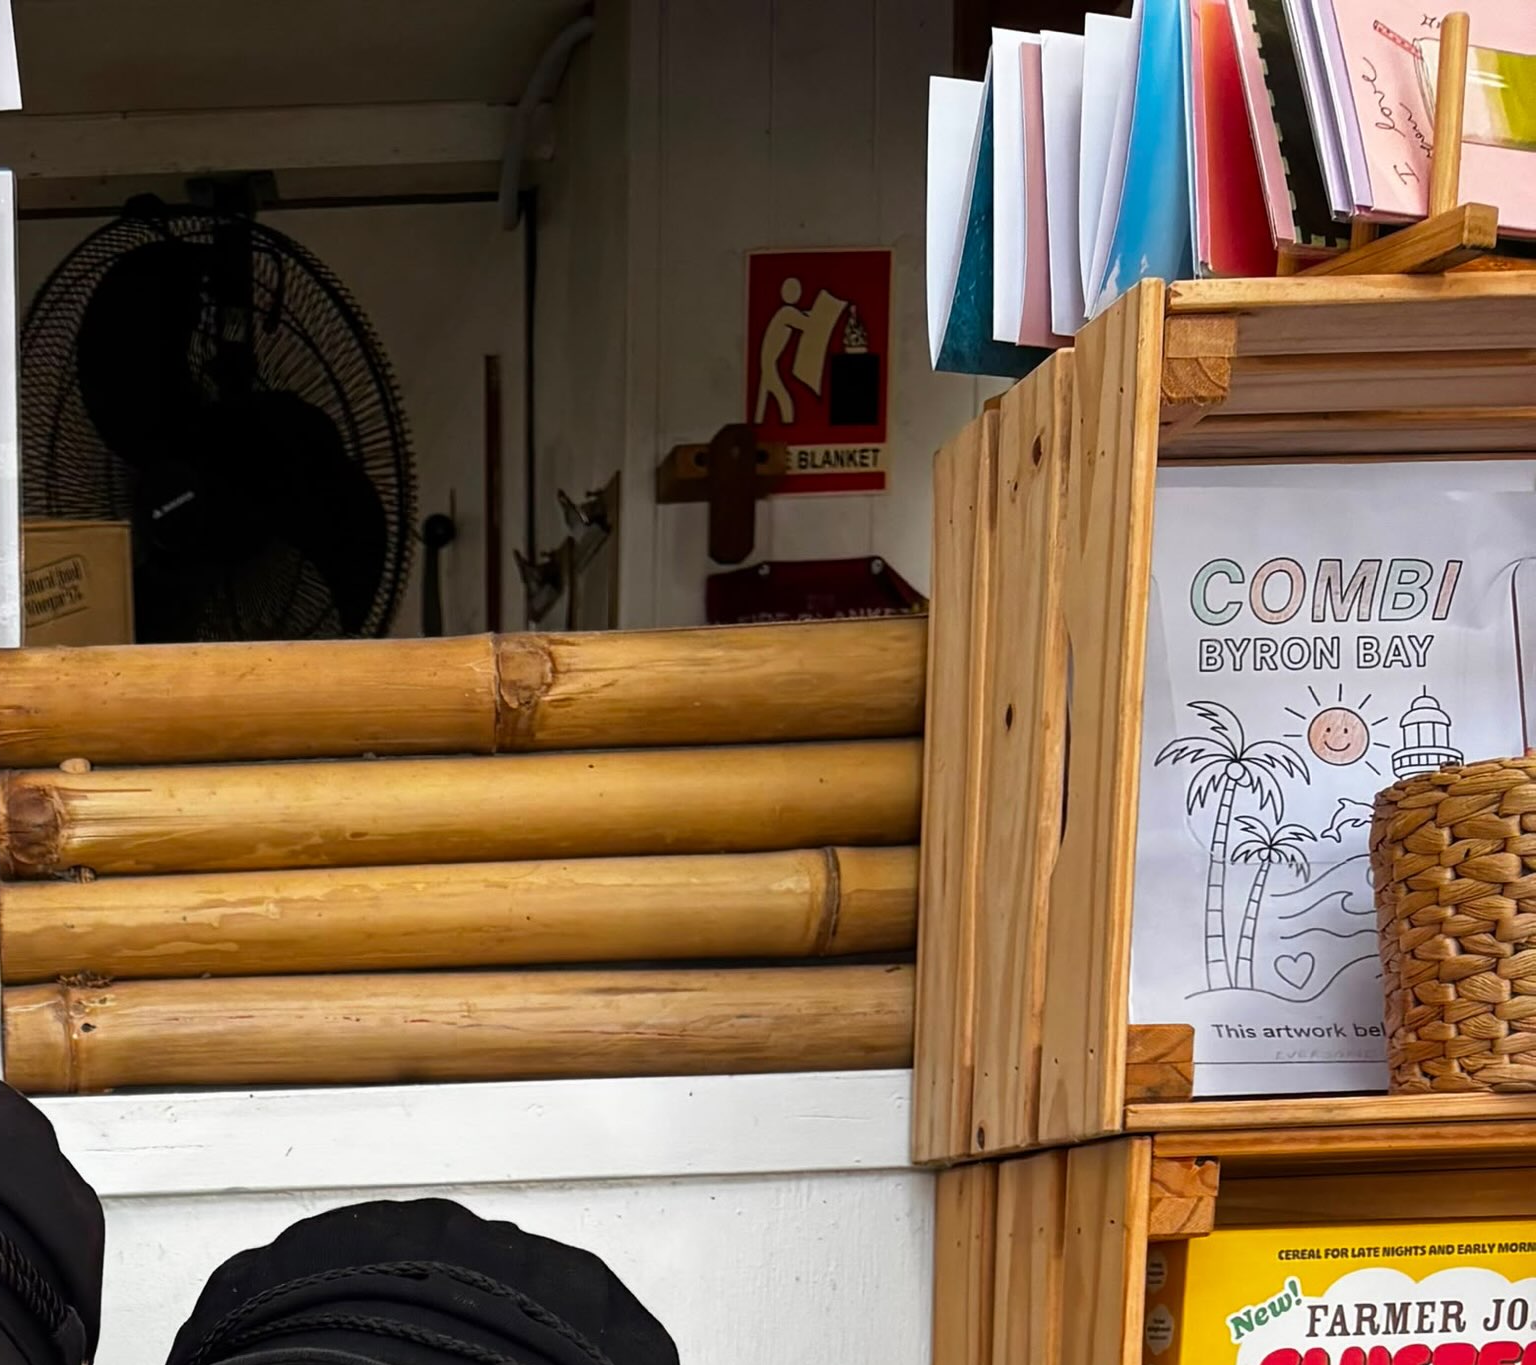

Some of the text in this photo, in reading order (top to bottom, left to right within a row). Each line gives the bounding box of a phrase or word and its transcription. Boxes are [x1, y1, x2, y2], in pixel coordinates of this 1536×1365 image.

[1361, 56, 1406, 138] love
[797, 448, 881, 470] BLANKET
[1189, 557, 1463, 626] COMBI
[1198, 634, 1435, 673] BYRON BAY
[1211, 1021, 1386, 1039] This artwork bel
[1277, 1248, 1322, 1260] CEREAL
[1324, 1247, 1349, 1259] FOR
[1351, 1246, 1380, 1258] LATE
[1382, 1245, 1427, 1258] NIGHTS
[1428, 1244, 1455, 1256] AND
[1457, 1242, 1496, 1255] EARLY
[1229, 1279, 1302, 1340] New!
[1305, 1300, 1467, 1338] FARMER
